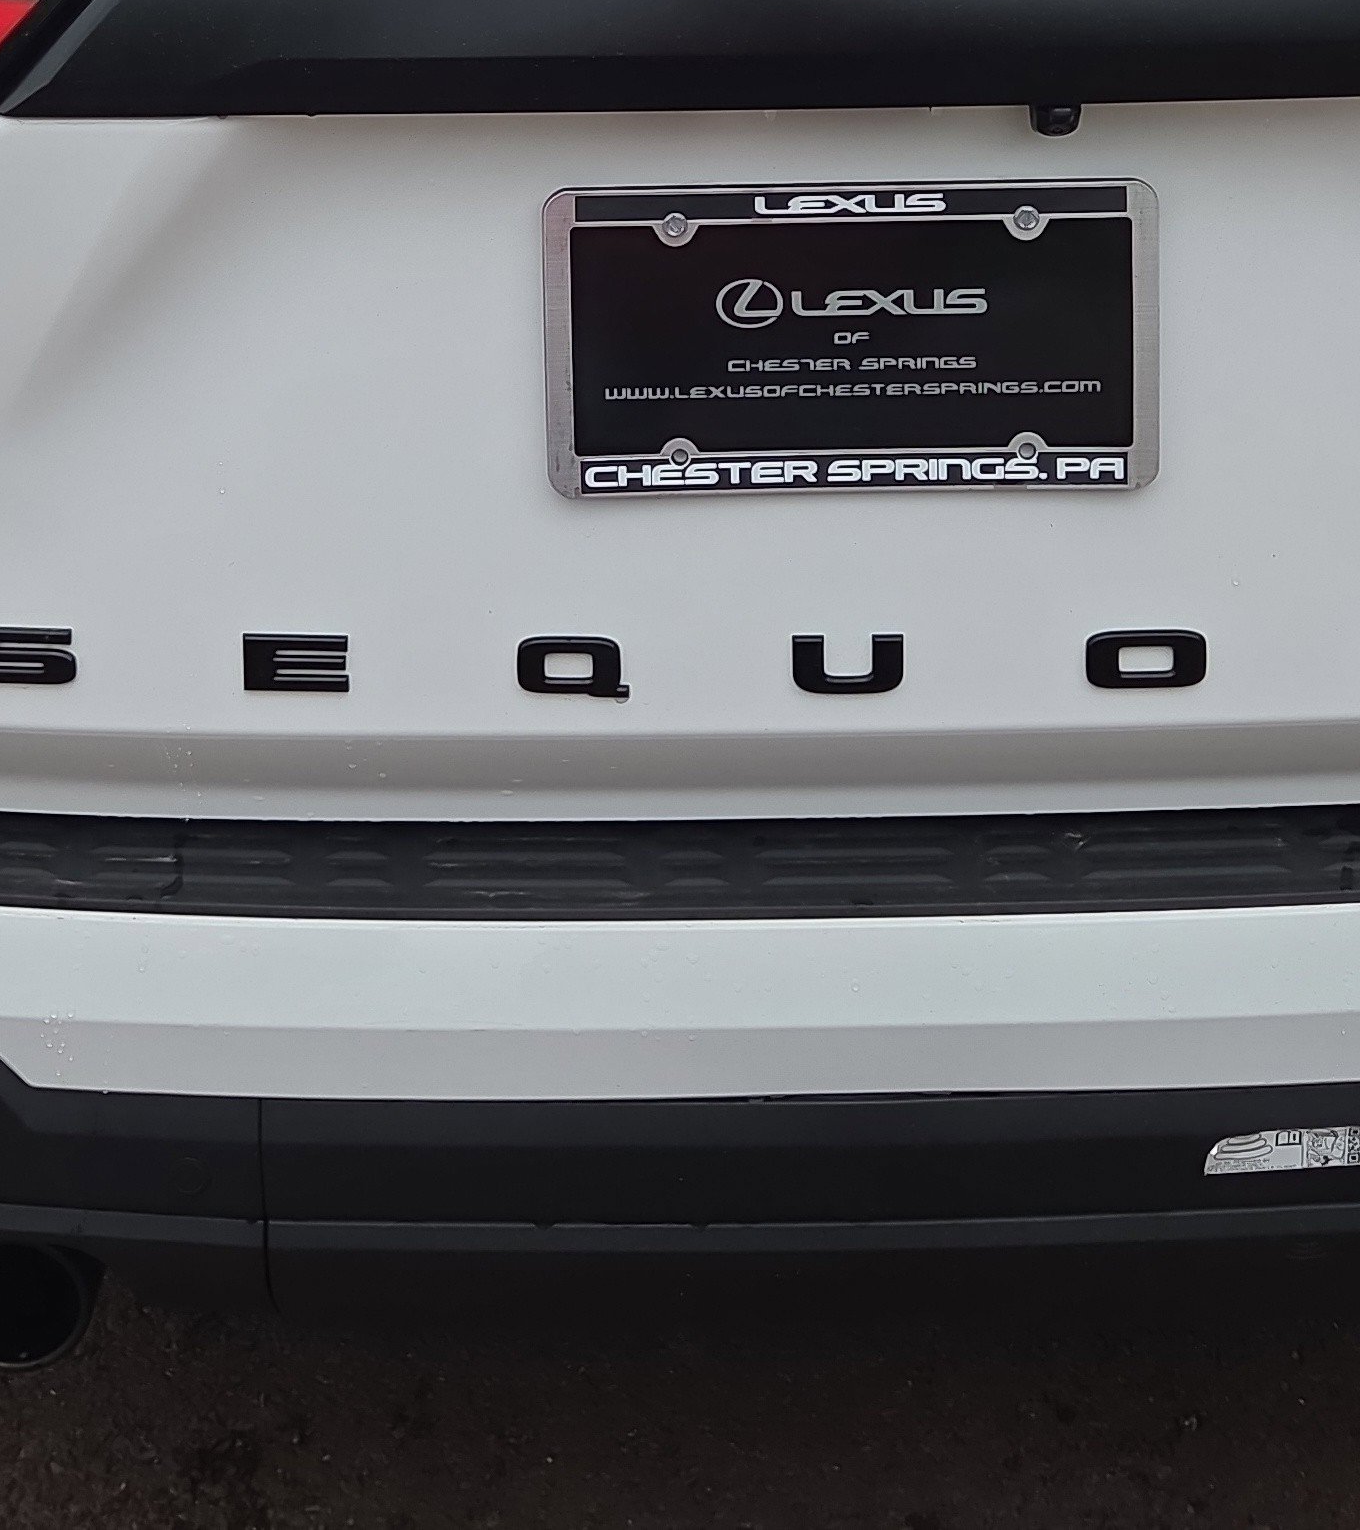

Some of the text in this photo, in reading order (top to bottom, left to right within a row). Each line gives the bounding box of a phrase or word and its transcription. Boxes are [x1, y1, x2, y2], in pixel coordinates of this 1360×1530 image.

[754, 192, 947, 215] LEXUS
[791, 288, 988, 318] LEXUS
[833, 331, 870, 345] OF
[727, 356, 978, 373] CHESTER SPRINGS
[584, 460, 820, 489] CHESTER
[1056, 457, 1126, 481] PA
